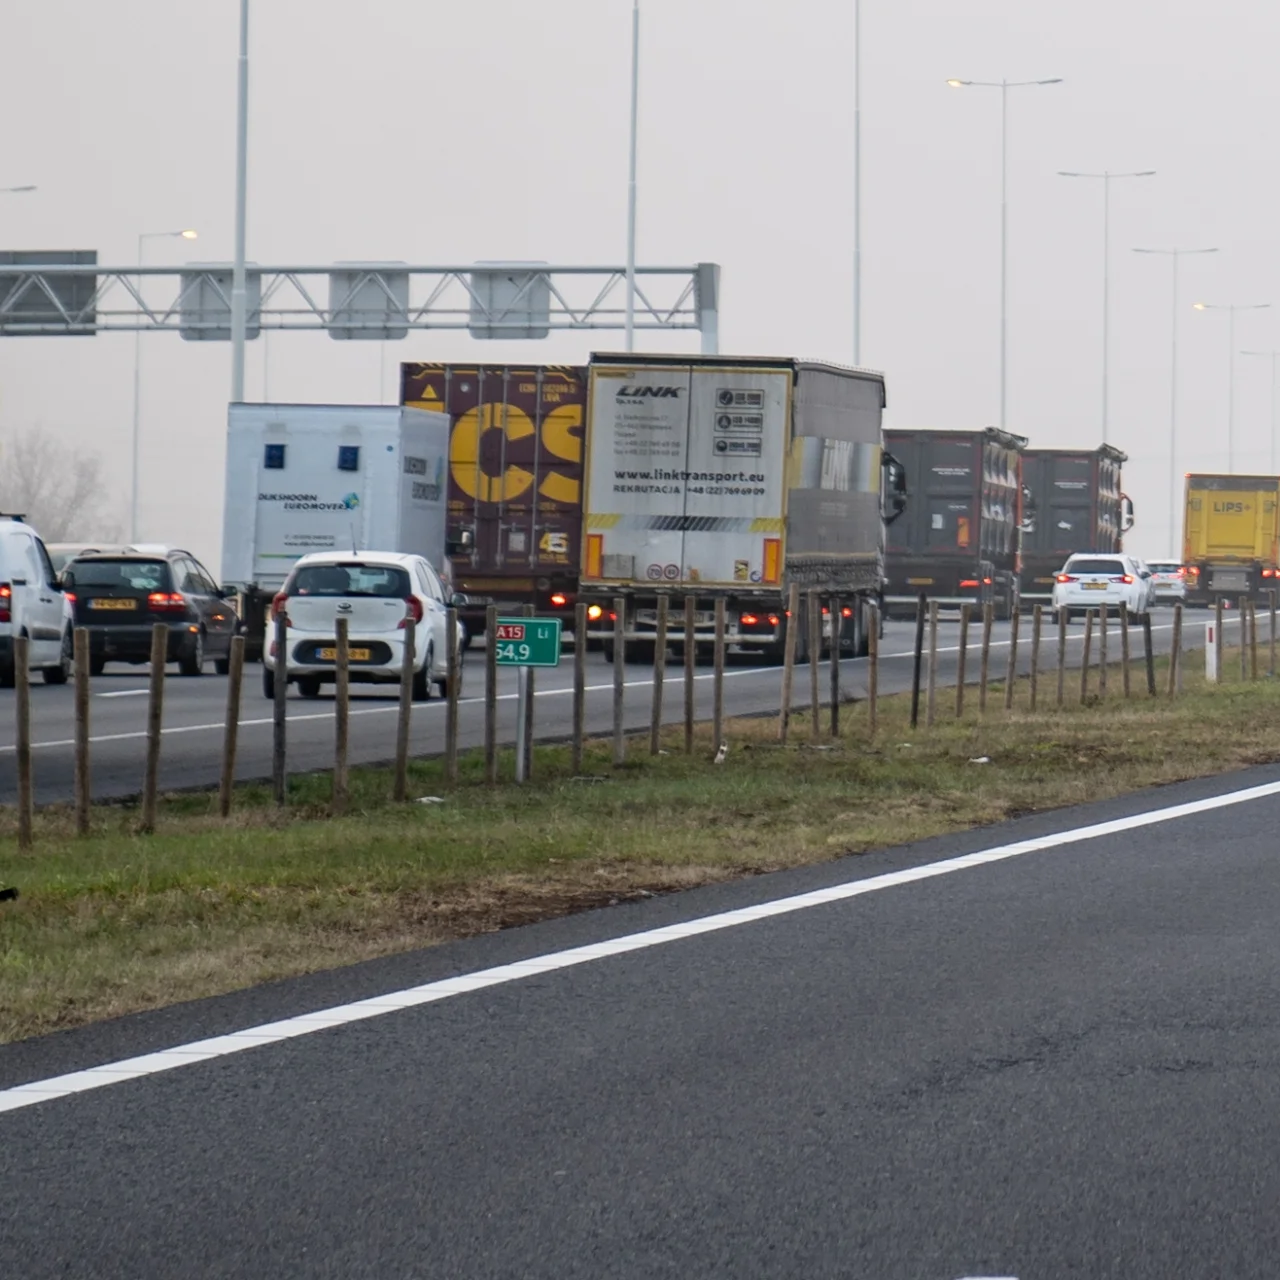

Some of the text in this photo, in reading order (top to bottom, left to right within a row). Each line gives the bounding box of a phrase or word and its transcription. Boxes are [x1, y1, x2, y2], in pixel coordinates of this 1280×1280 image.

[614, 468, 765, 483] www.linktransport.eu
[613, 484, 681, 494] REKRUTACJA
[495, 626, 522, 638] A15
[537, 627, 549, 639] Li
